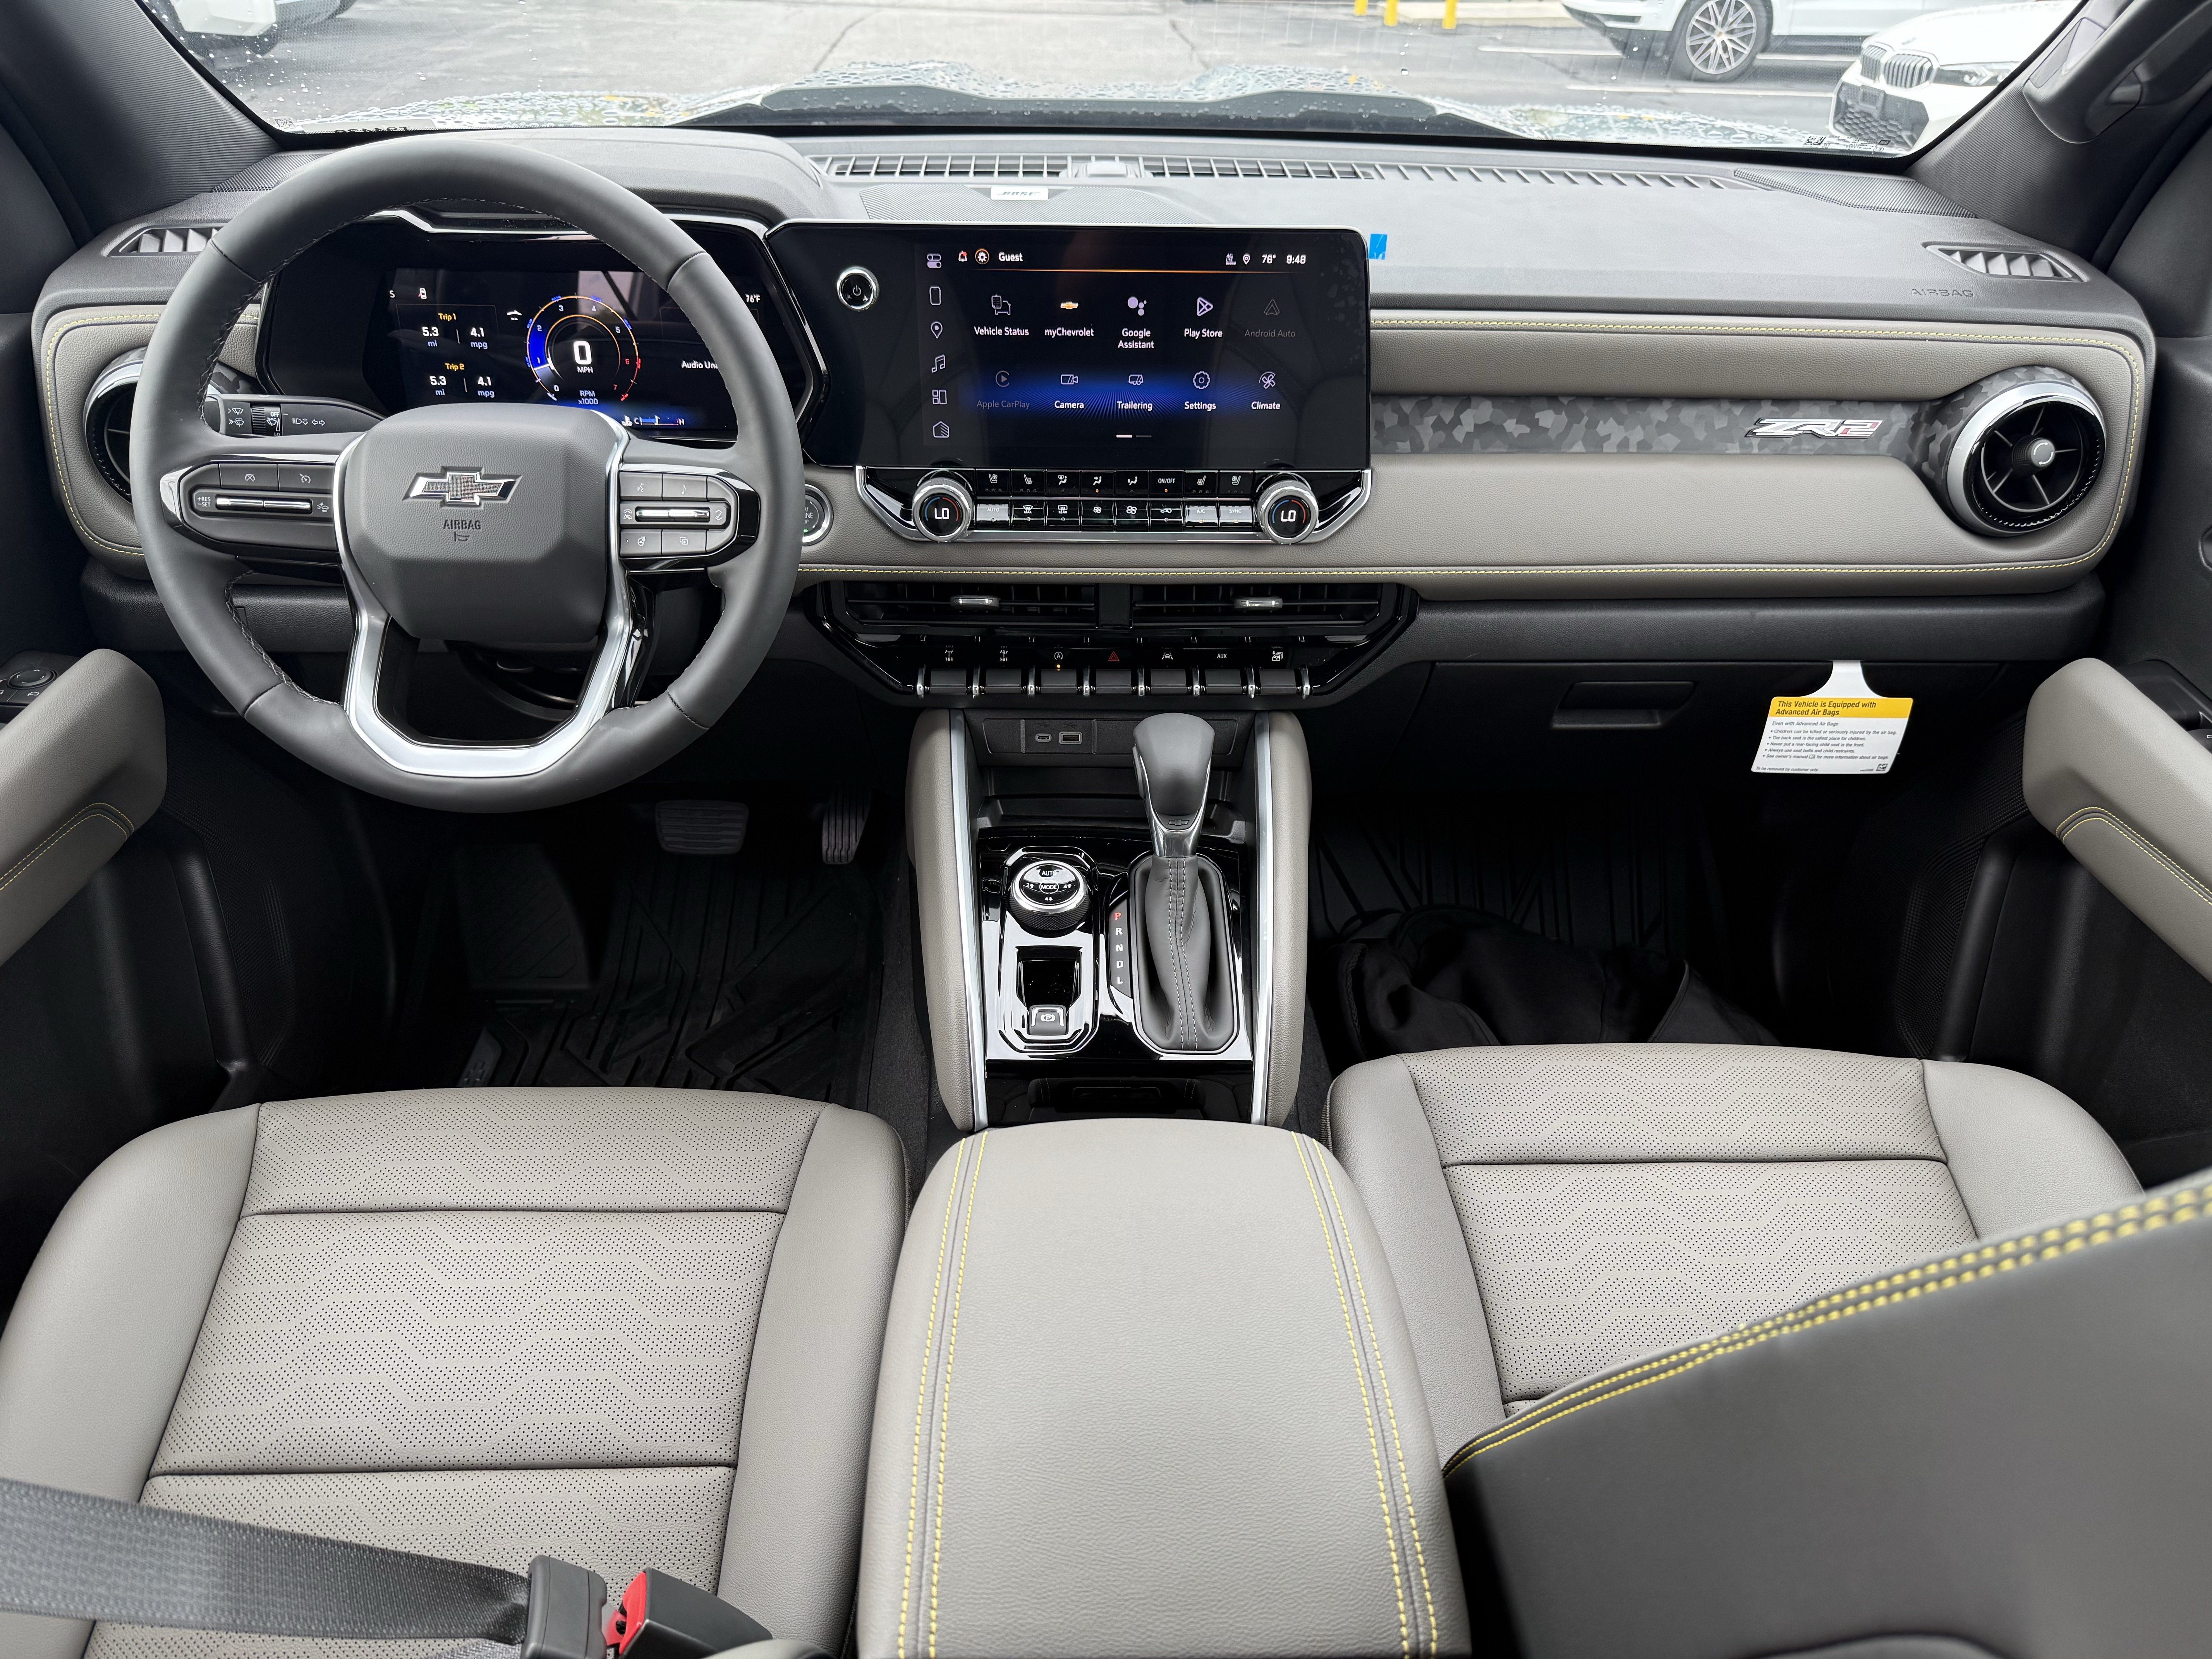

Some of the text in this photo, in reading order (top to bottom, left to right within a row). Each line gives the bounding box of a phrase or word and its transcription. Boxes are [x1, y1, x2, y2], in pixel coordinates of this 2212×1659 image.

[998, 251, 1023, 261] Guest
[1911, 289, 1974, 297] AIRBAG
[745, 294, 761, 303] 76°F
[438, 313, 452, 321] Trip
[422, 326, 484, 337] 5.3 4.1
[974, 326, 1029, 336] Vehicle Status
[1044, 327, 1094, 338] myChevrolet
[1122, 328, 1151, 339] Google
[1184, 328, 1223, 339] Play Store
[1244, 329, 1276, 337] Android
[471, 341, 488, 349] mpg
[1118, 340, 1154, 349] Assistant
[573, 340, 592, 365] 0
[445, 363, 459, 371] Trip
[681, 360, 703, 369] Audio
[430, 376, 491, 386] 5.3 4.1
[477, 390, 495, 398] mpg
[977, 400, 1030, 410] Apple CarPlay
[1054, 400, 1084, 409] Camera
[1117, 401, 1153, 411] Trailering
[1184, 401, 1216, 411] Settings
[1251, 401, 1281, 410] Climate
[1745, 418, 1883, 438] ZR2
[934, 508, 950, 519] LO
[1281, 510, 1296, 522] LO
[443, 519, 481, 530] AIRBAG
[1116, 944, 1123, 952] N
